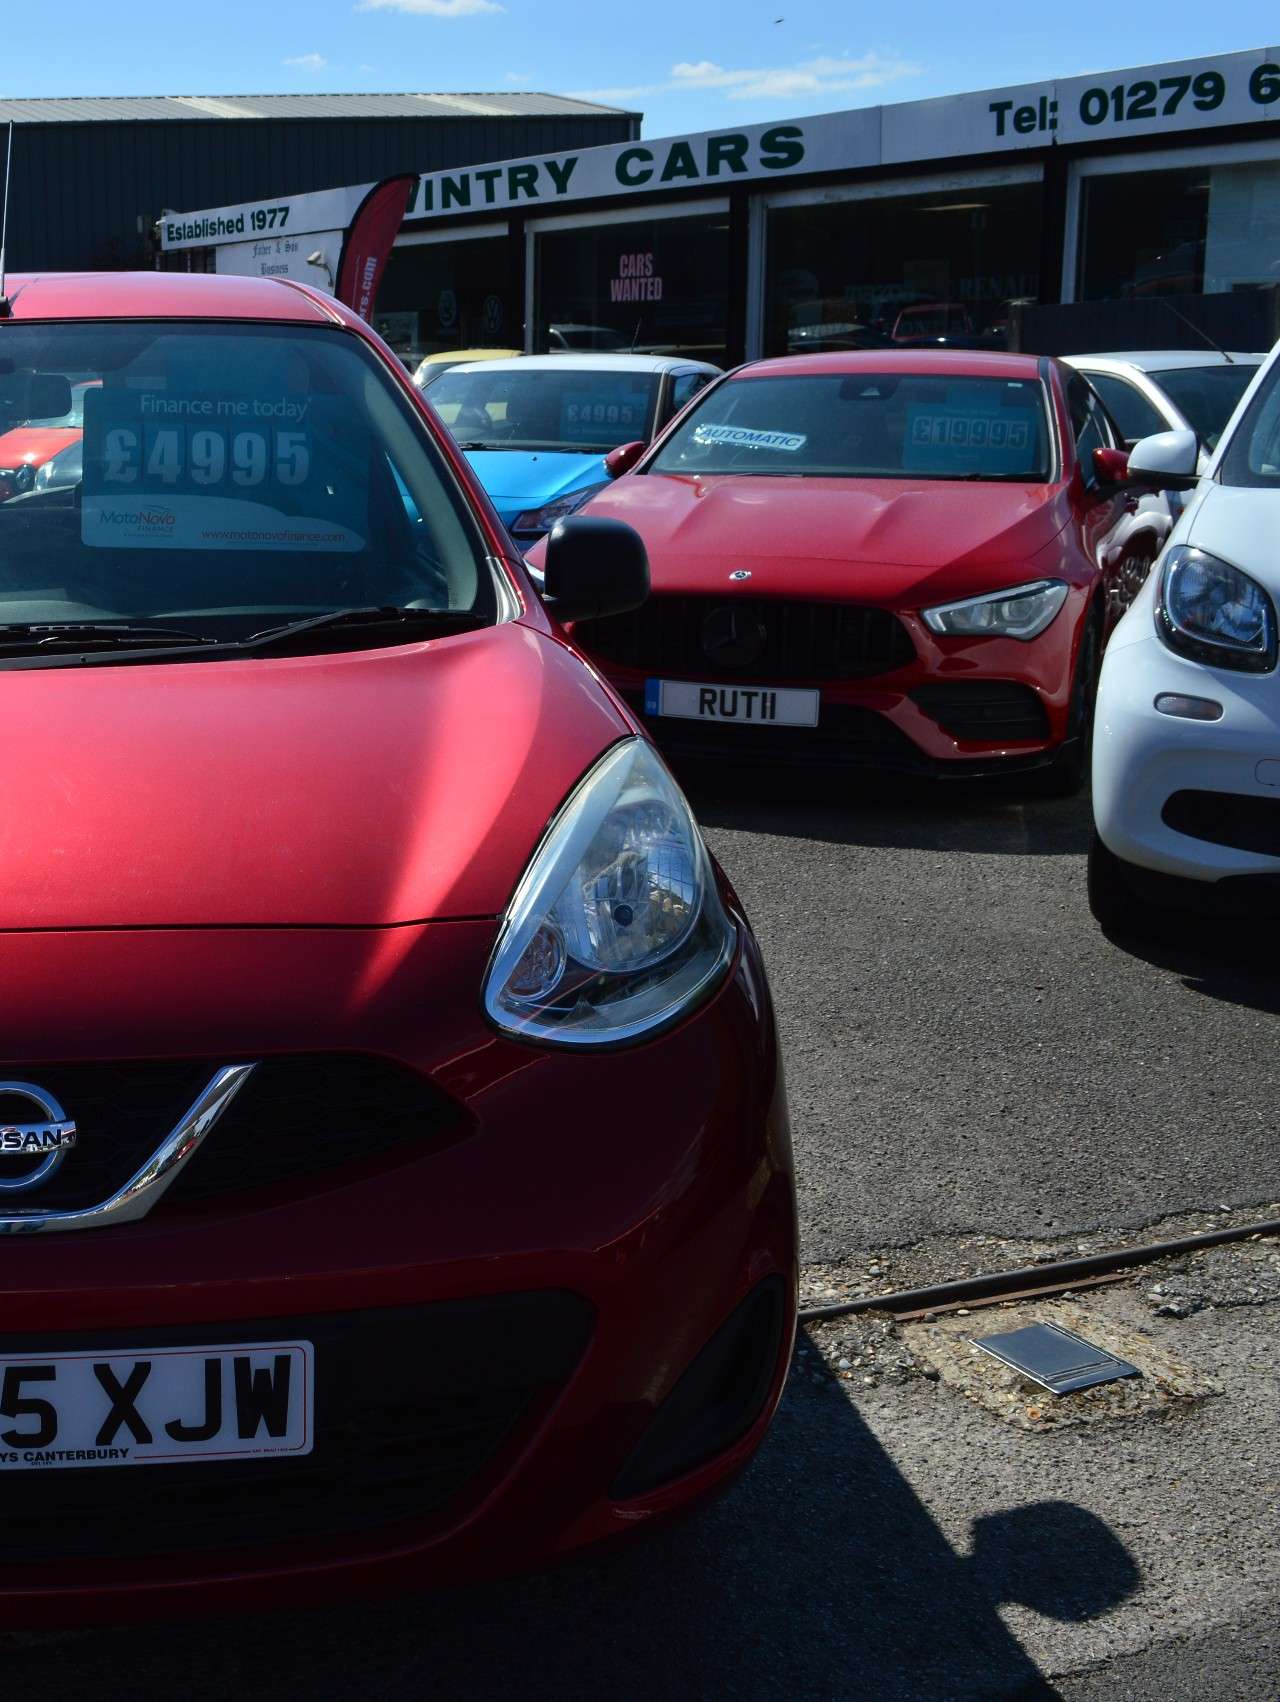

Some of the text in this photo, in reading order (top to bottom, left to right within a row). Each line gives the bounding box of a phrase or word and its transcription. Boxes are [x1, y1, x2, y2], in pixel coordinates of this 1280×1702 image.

[989, 96, 1058, 136] Tel:
[1079, 71, 1225, 126] 01279
[615, 126, 805, 186] CARS
[167, 206, 290, 242] Established 1977
[619, 254, 653, 277] CARS
[610, 277, 663, 302] WANTED
[140, 395, 211, 415] Finance
[217, 401, 247, 416] me
[703, 428, 800, 447] AUTOMATIC
[911, 416, 1029, 450] £19995
[104, 428, 310, 487] £4995
[100, 510, 176, 525] MotoNovo
[93, 1354, 291, 1446] XJW
[23, 1448, 130, 1463] CANTERBURY
